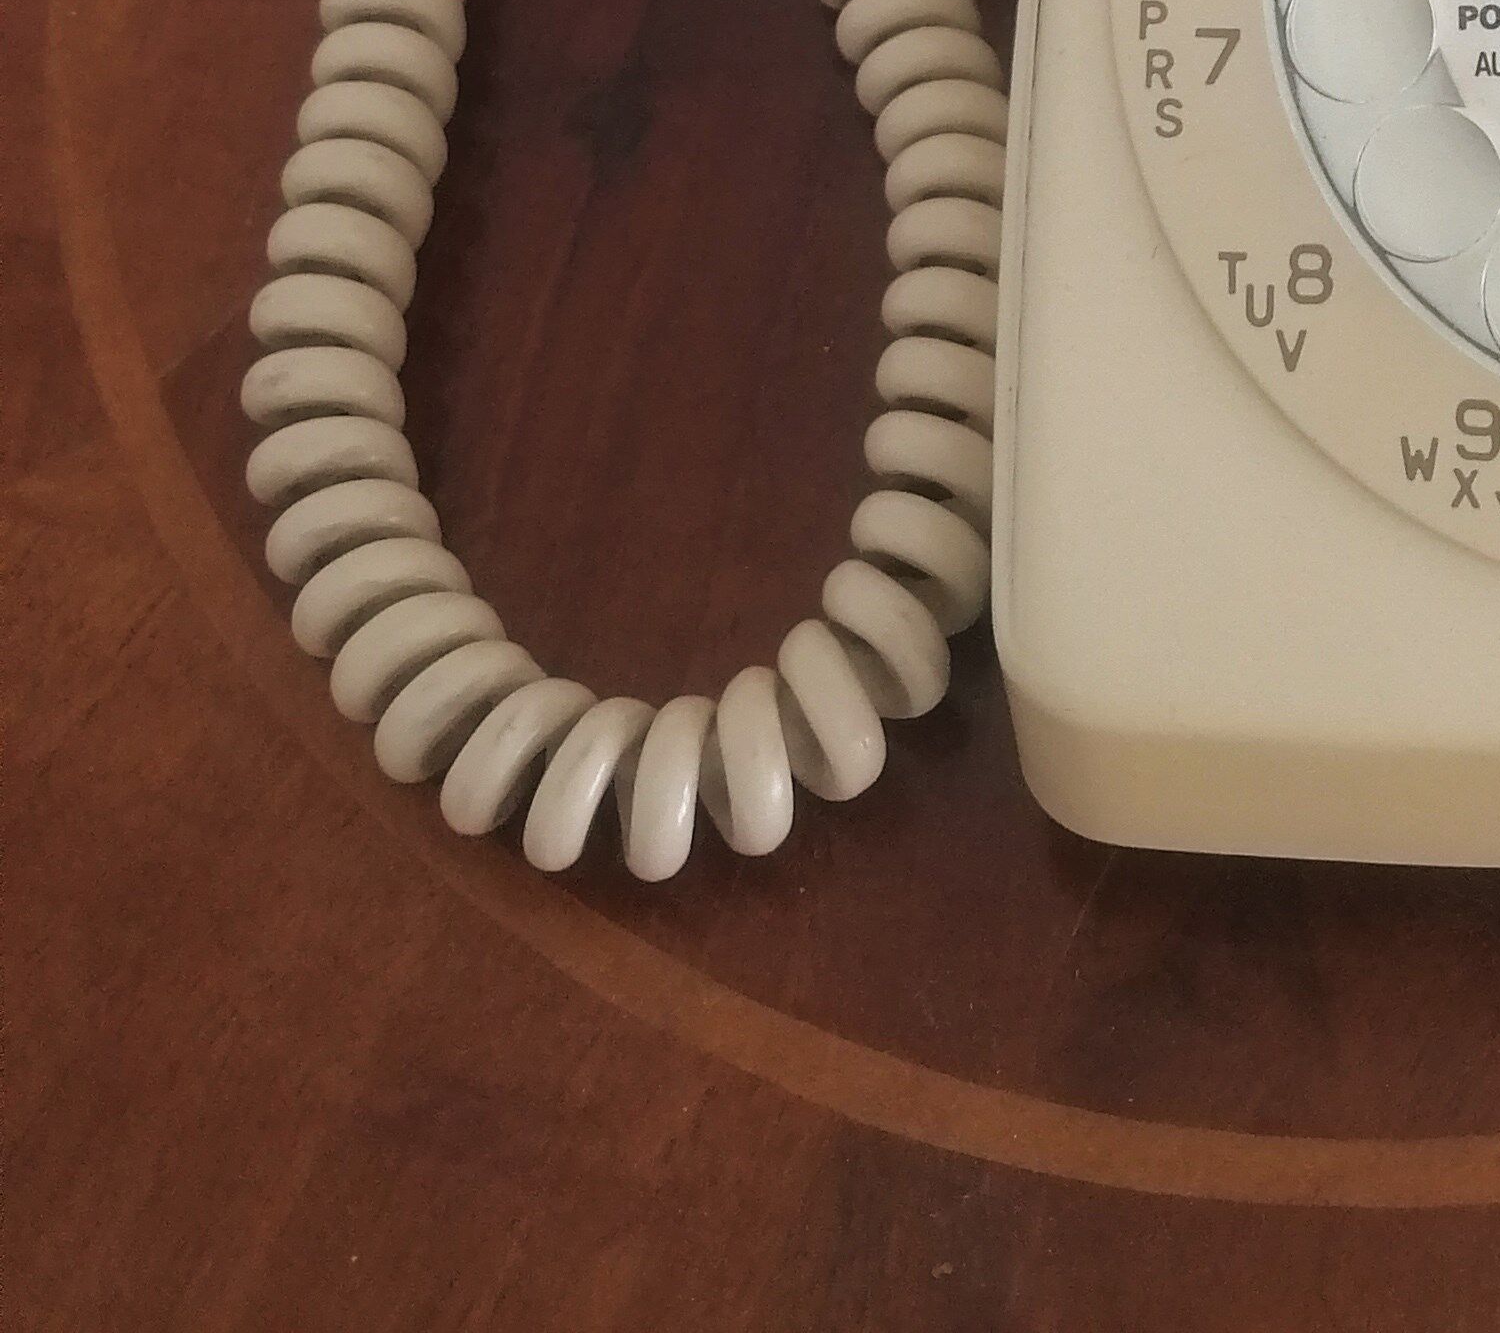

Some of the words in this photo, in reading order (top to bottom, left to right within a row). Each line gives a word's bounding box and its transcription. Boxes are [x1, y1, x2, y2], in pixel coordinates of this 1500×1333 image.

[1194, 28, 1241, 85] 7
[1287, 244, 1334, 304] 8
[1456, 399, 1500, 461] 9
